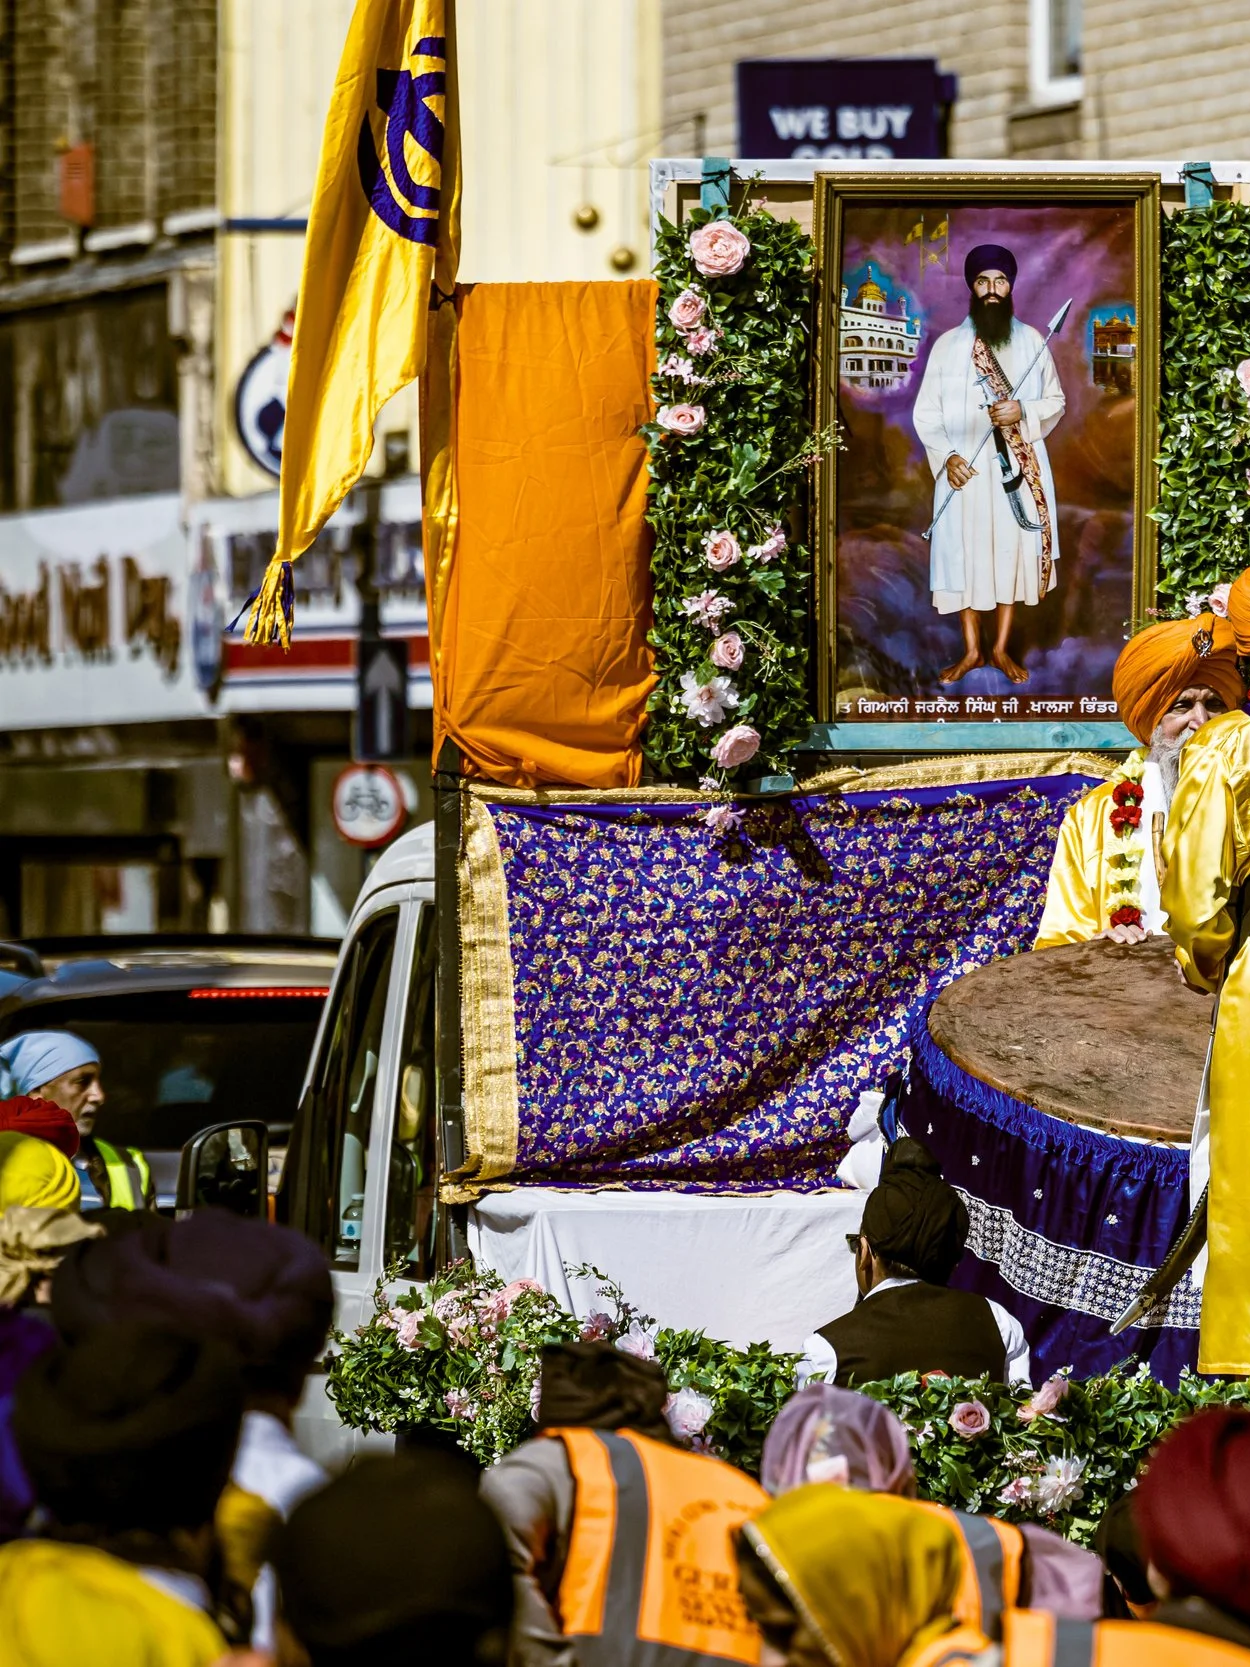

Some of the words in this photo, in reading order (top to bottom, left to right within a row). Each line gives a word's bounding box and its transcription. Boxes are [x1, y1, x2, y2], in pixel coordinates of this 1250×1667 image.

[768, 106, 829, 139] WE
[836, 106, 912, 138] BUY
[965, 697, 997, 713] ਸਿੰਘ
[1002, 697, 1019, 713] ਜੀ
